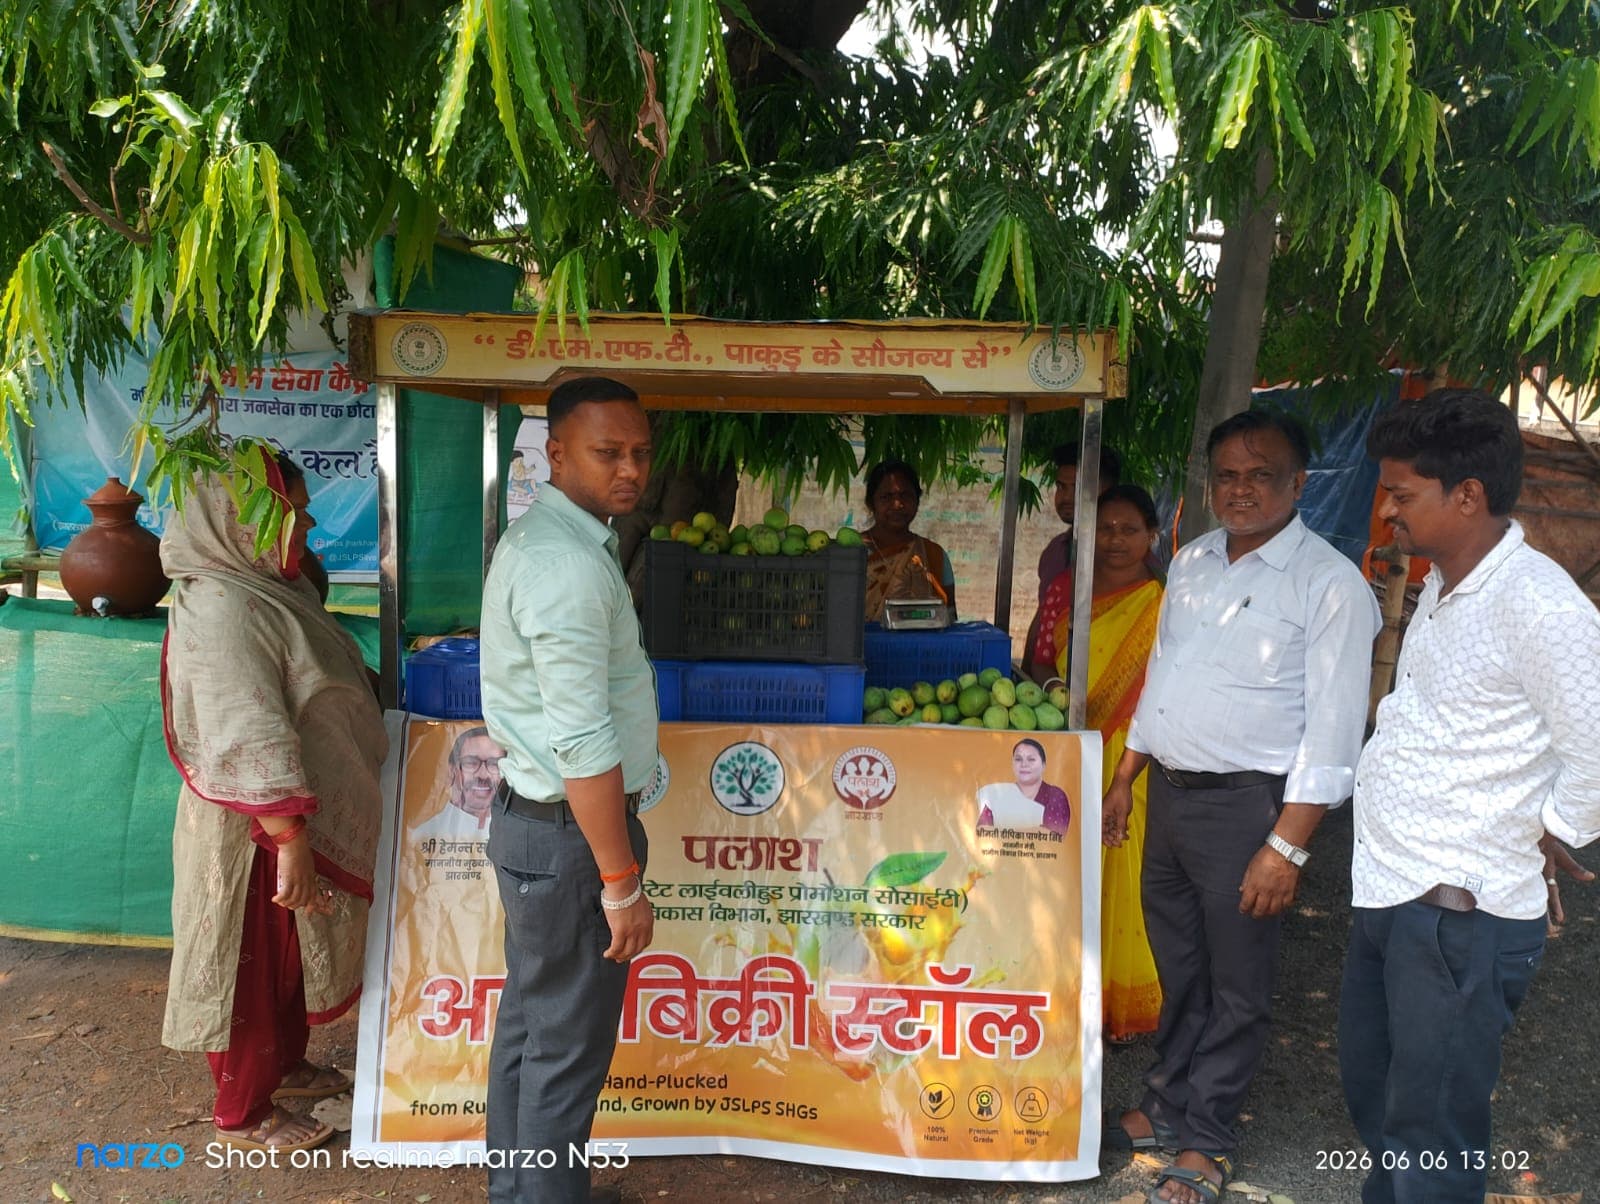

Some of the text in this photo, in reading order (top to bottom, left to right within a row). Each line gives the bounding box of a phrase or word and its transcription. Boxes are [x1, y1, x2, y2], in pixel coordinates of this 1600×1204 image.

[811, 338, 844, 366] के
[850, 337, 955, 368] सौजन्य
[269, 358, 325, 392] सेवा
[242, 396, 296, 416] जनसेवा
[298, 403, 318, 417] का
[320, 404, 344, 419] एक
[345, 400, 377, 419] छोटा
[421, 838, 436, 854] श्री
[681, 836, 824, 872] पलाश
[678, 878, 784, 905] लाईवलीहुड
[788, 881, 869, 904] प्रोमोशन
[708, 902, 771, 924] विभाग,
[777, 908, 855, 928] झारखण्ड
[860, 912, 927, 930] सरकार
[619, 952, 817, 1050] बिक्री
[829, 962, 1052, 1061] स्टॉल
[603, 1074, 728, 1090] Hand-Plucked
[409, 1100, 457, 1116] from
[462, 1099, 486, 1115] Ru
[631, 1096, 689, 1112] Grown
[694, 1096, 716, 1115] by
[720, 1096, 771, 1115] JSLPS
[775, 1101, 818, 1120] SHGs
